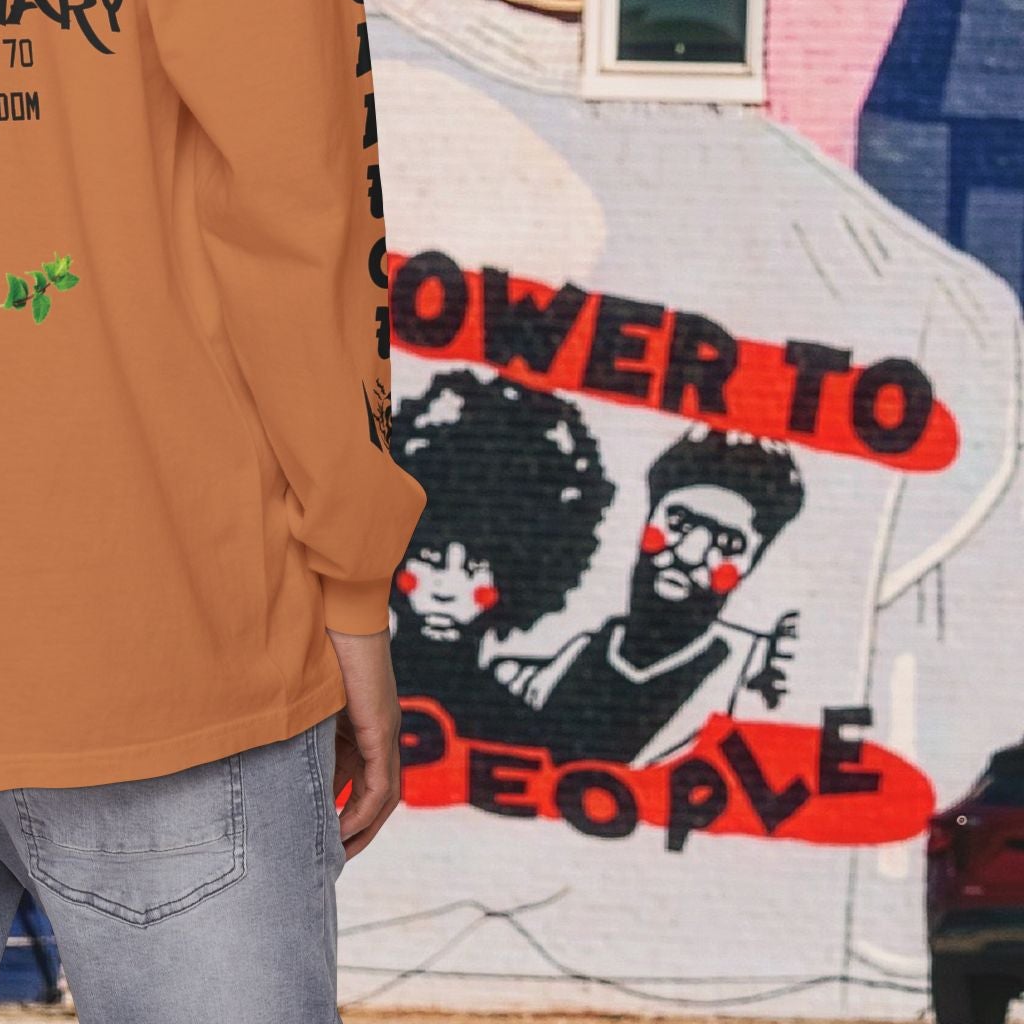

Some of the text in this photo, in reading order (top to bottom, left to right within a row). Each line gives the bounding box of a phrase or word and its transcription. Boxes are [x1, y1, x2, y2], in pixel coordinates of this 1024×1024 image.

[2, 38, 35, 68] 70
[388, 250, 934, 456] OWER TO
